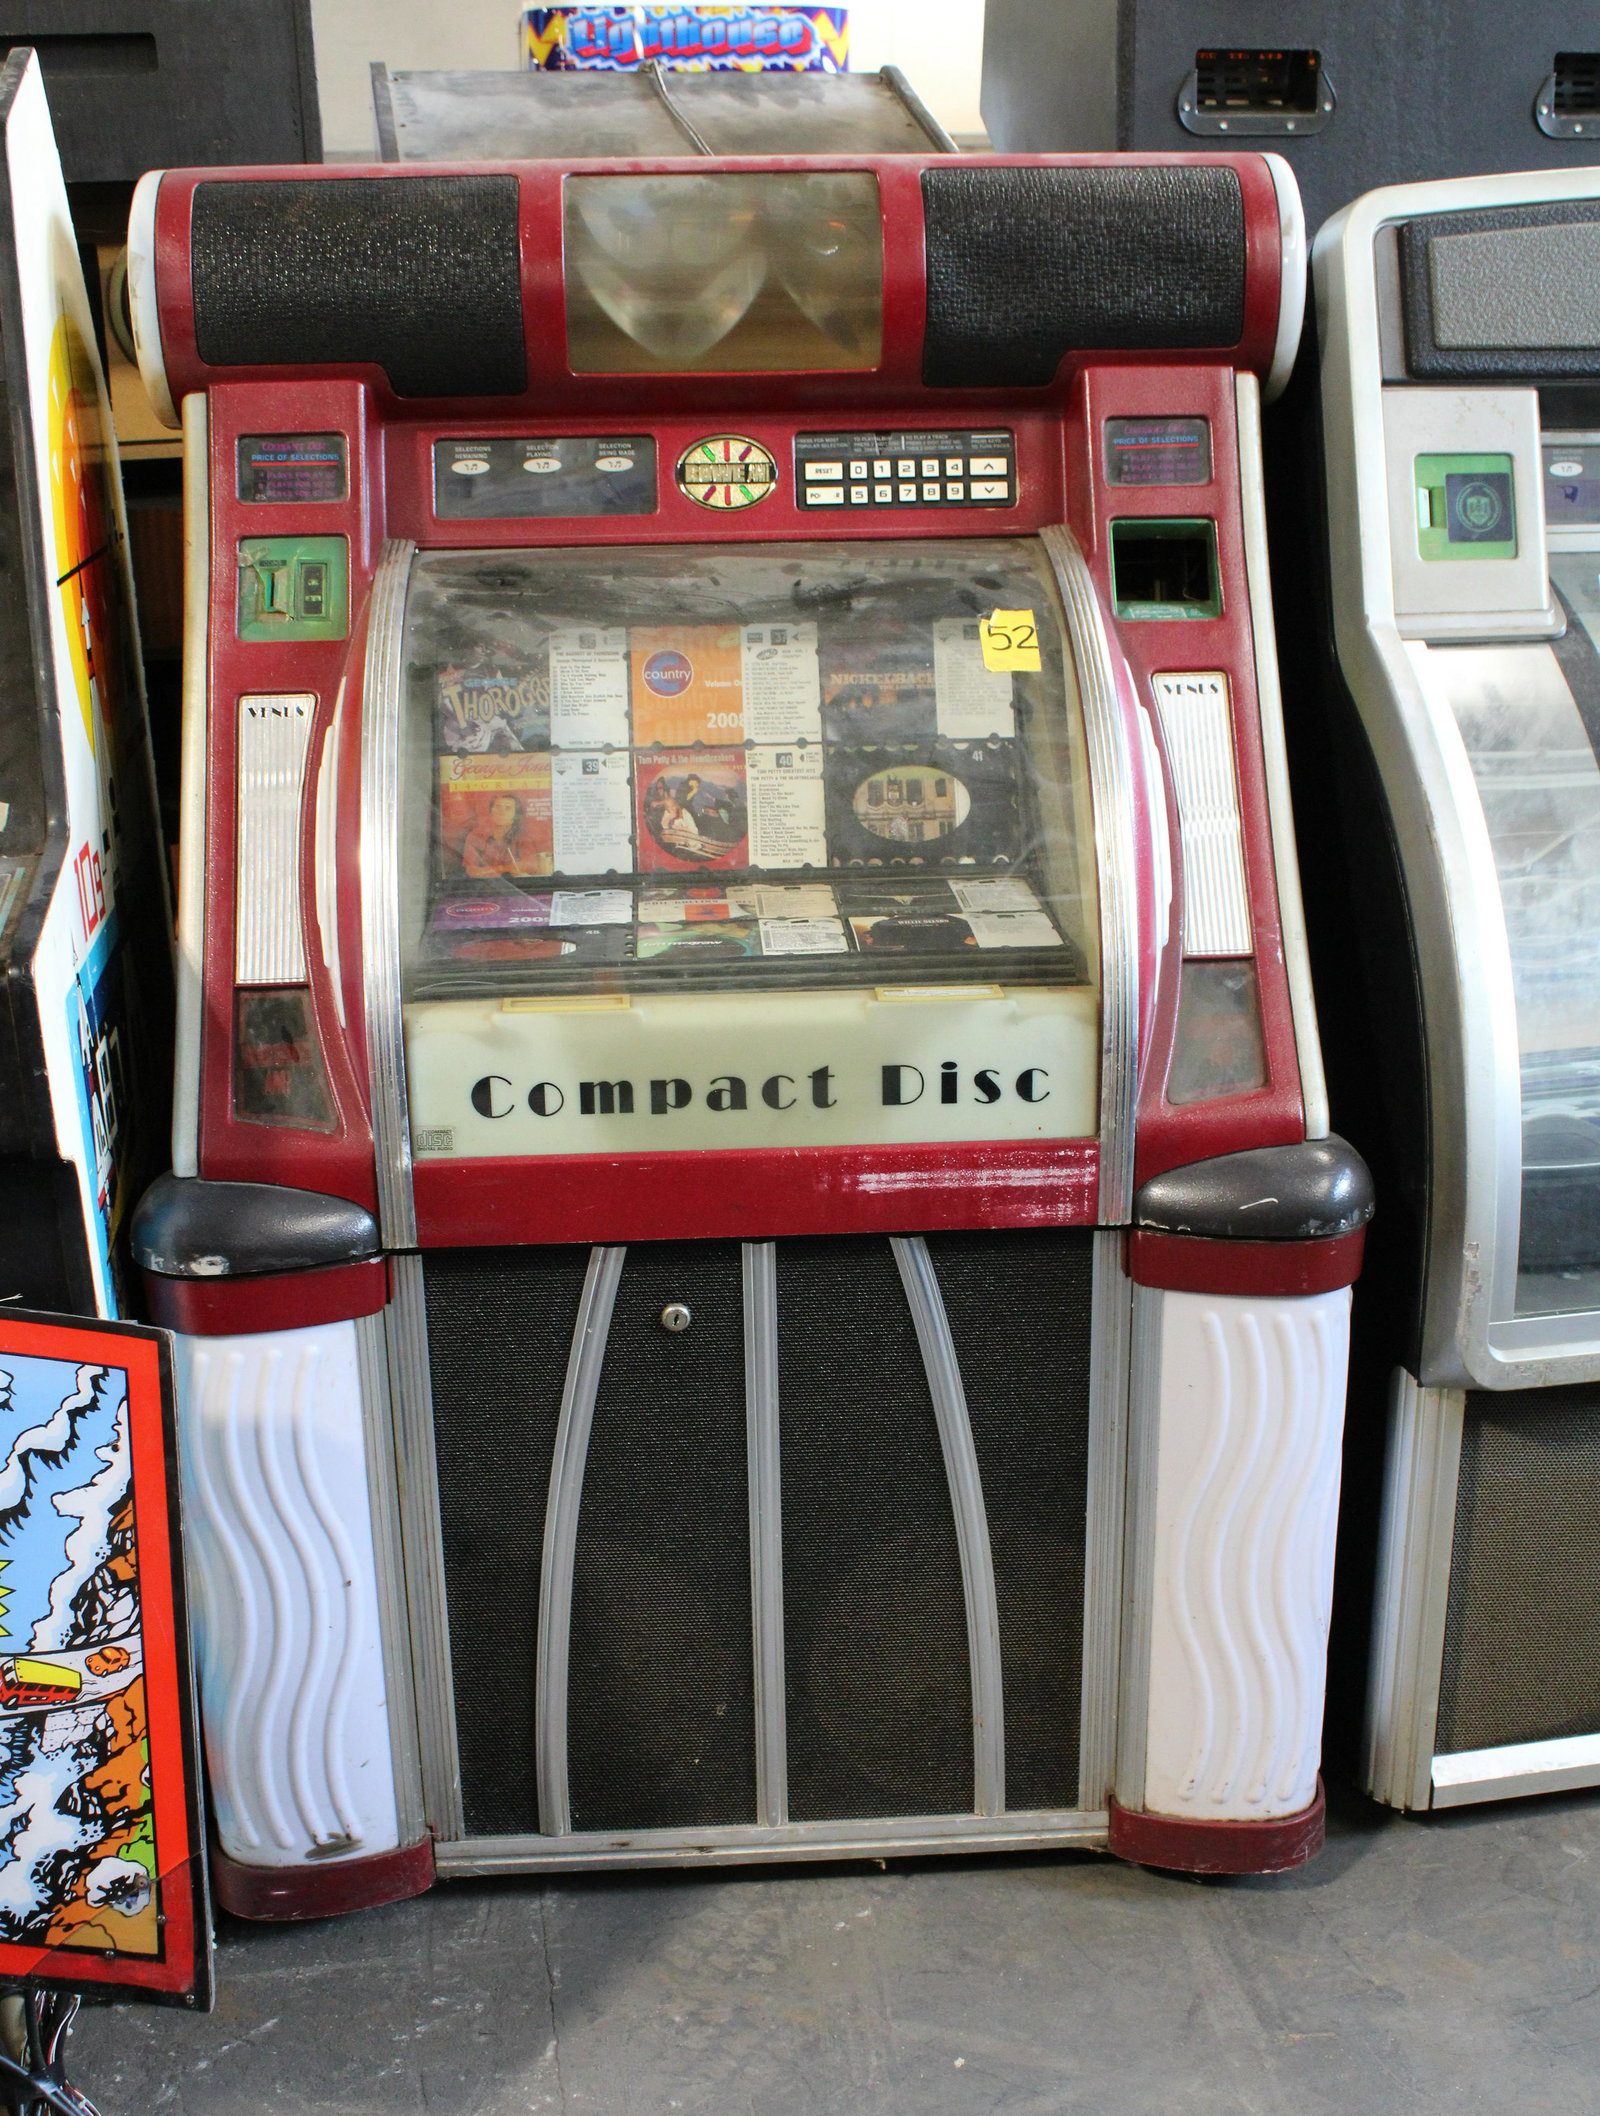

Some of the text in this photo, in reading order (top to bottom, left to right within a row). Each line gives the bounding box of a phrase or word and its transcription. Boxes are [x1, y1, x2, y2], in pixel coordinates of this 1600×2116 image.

[290, 453, 339, 461] SELECTIONS
[855, 465, 863, 475] 0
[902, 464, 911, 472] 2
[926, 464, 935, 472] 3
[950, 463, 959, 471] 4
[855, 487, 960, 499] 5 6 7 8 9
[987, 624, 1040, 651] 52
[644, 669, 691, 681] country
[638, 755, 652, 765] Tom
[653, 754, 670, 766] Petty
[779, 755, 793, 766] 40
[972, 750, 983, 761] 41
[585, 761, 599, 772] 39
[470, 1061, 1051, 1119] Compact Disc
[416, 1129, 454, 1147] disc
